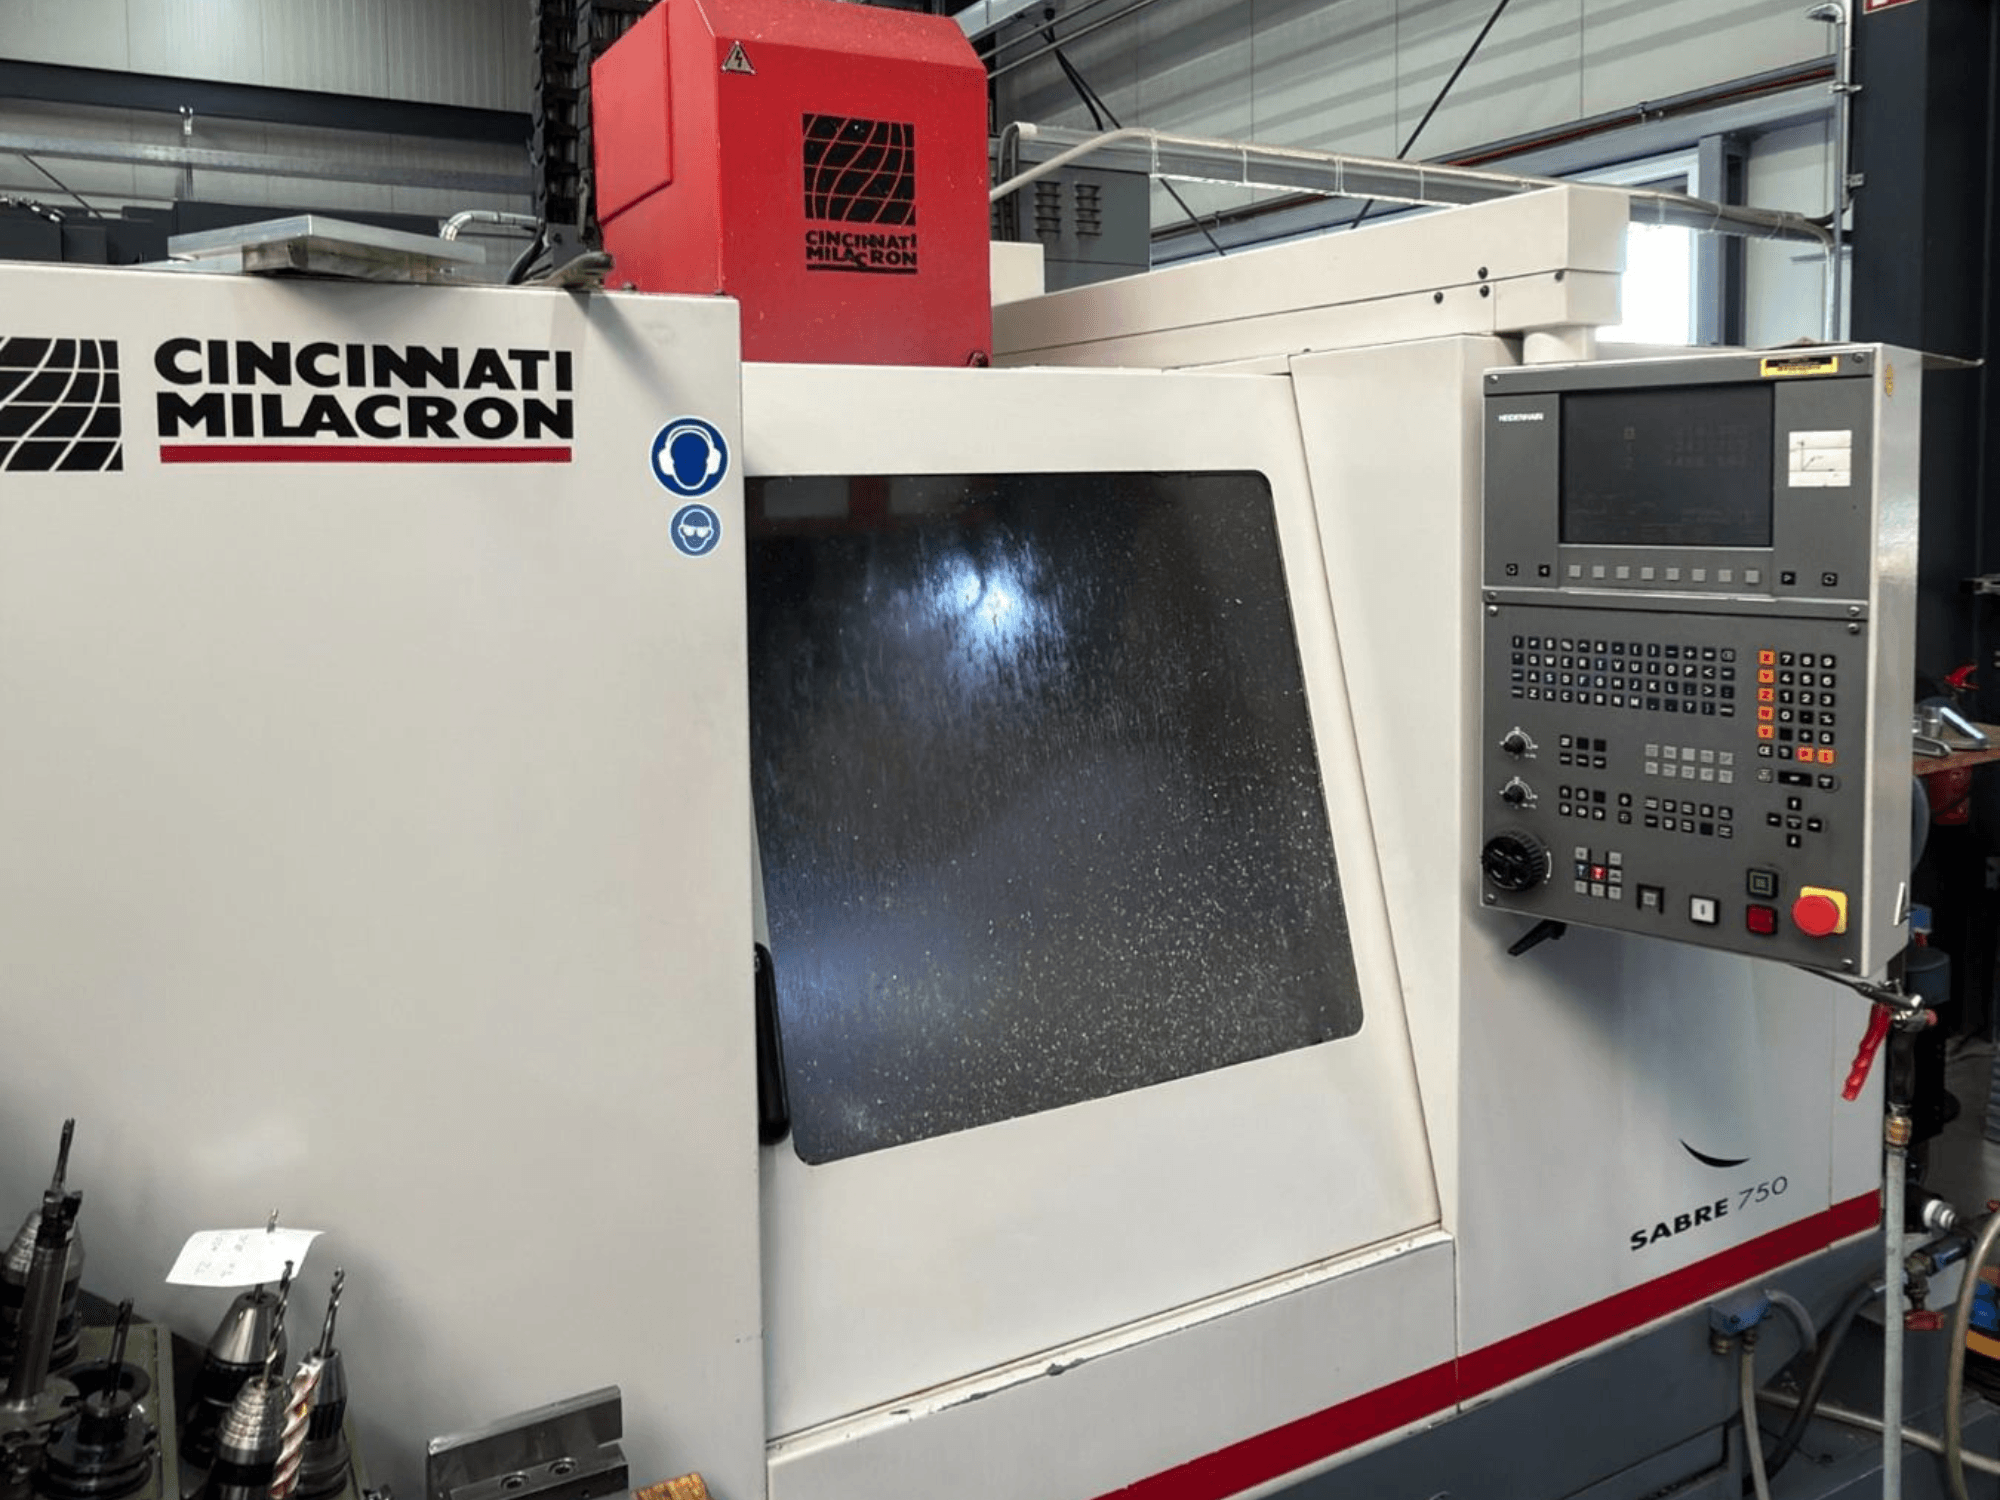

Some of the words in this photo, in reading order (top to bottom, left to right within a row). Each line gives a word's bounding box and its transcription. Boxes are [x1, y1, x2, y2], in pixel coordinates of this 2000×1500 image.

[805, 230, 917, 248] CINCINNATI
[806, 246, 918, 268] MILACRON
[154, 337, 573, 392] CINCINNATI
[156, 391, 574, 440] MILACRON
[1545, 656, 1554, 665] W
[1562, 657, 1570, 667] E
[1631, 663, 1639, 672] U
[1667, 665, 1675, 674] O
[1685, 666, 1694, 676] P
[1782, 654, 1791, 664] 7
[1802, 656, 1811, 665] 8
[1823, 657, 1833, 667] 9
[1529, 672, 1537, 681] A
[1546, 673, 1554, 683] S
[1613, 679, 1622, 688] H
[1649, 682, 1657, 691] K
[1667, 683, 1675, 692] L
[1781, 674, 1791, 683] 4
[1802, 675, 1811, 684] 5
[1822, 676, 1832, 686] 6
[1529, 688, 1538, 698] Z
[1545, 690, 1554, 699] X
[1562, 691, 1570, 701] C
[1579, 692, 1587, 702] V
[1630, 697, 1640, 706] M
[1761, 690, 1771, 700] Z
[1801, 693, 1811, 703] 2
[1822, 695, 1832, 705] 3
[1630, 1197, 1730, 1252] SABRE
[1736, 1175, 1789, 1211] 750
